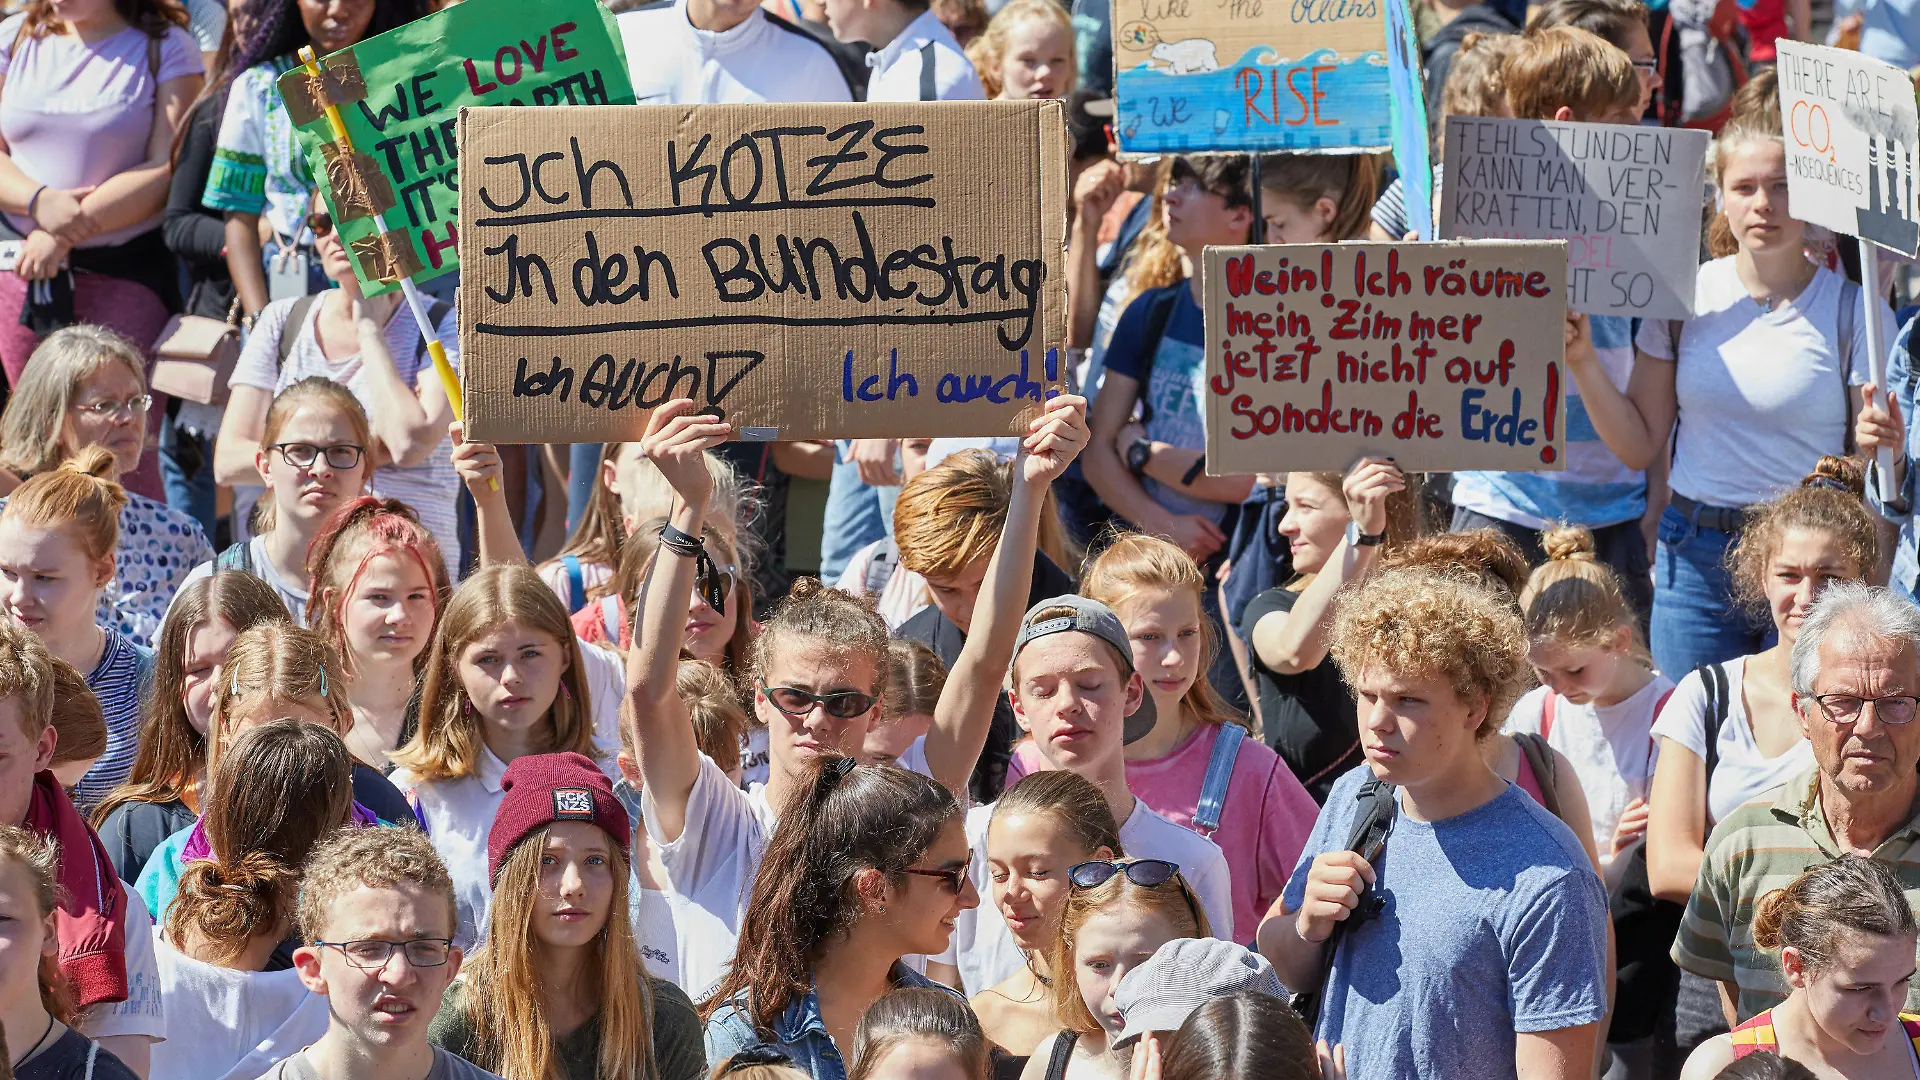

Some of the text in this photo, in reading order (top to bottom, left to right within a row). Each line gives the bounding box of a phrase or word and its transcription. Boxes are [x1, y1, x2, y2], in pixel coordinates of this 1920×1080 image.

[357, 21, 579, 132] WE LOVE
[1235, 66, 1341, 127] RISE
[1781, 51, 1890, 117] THERE ARE
[668, 119, 935, 218] KOTZE
[1457, 155, 1677, 200] KANN MAN VER-
[1595, 200, 1661, 236] DEN
[571, 230, 680, 307] den
[1225, 249, 1335, 307] Nein!
[1354, 248, 1412, 298] Ich
[1423, 259, 1551, 298] räume
[1610, 271, 1655, 308] SO
[1226, 299, 1483, 344] mein Zimmer
[842, 348, 1059, 404] Ich auch!
[1210, 336, 1516, 395] jetzt nicht auf
[1231, 379, 1383, 440] Sondern
[1391, 390, 1444, 439] die
[1460, 361, 1560, 464] Erde!
[556, 792, 589, 802] FCK
[557, 800, 591, 812] NZS
